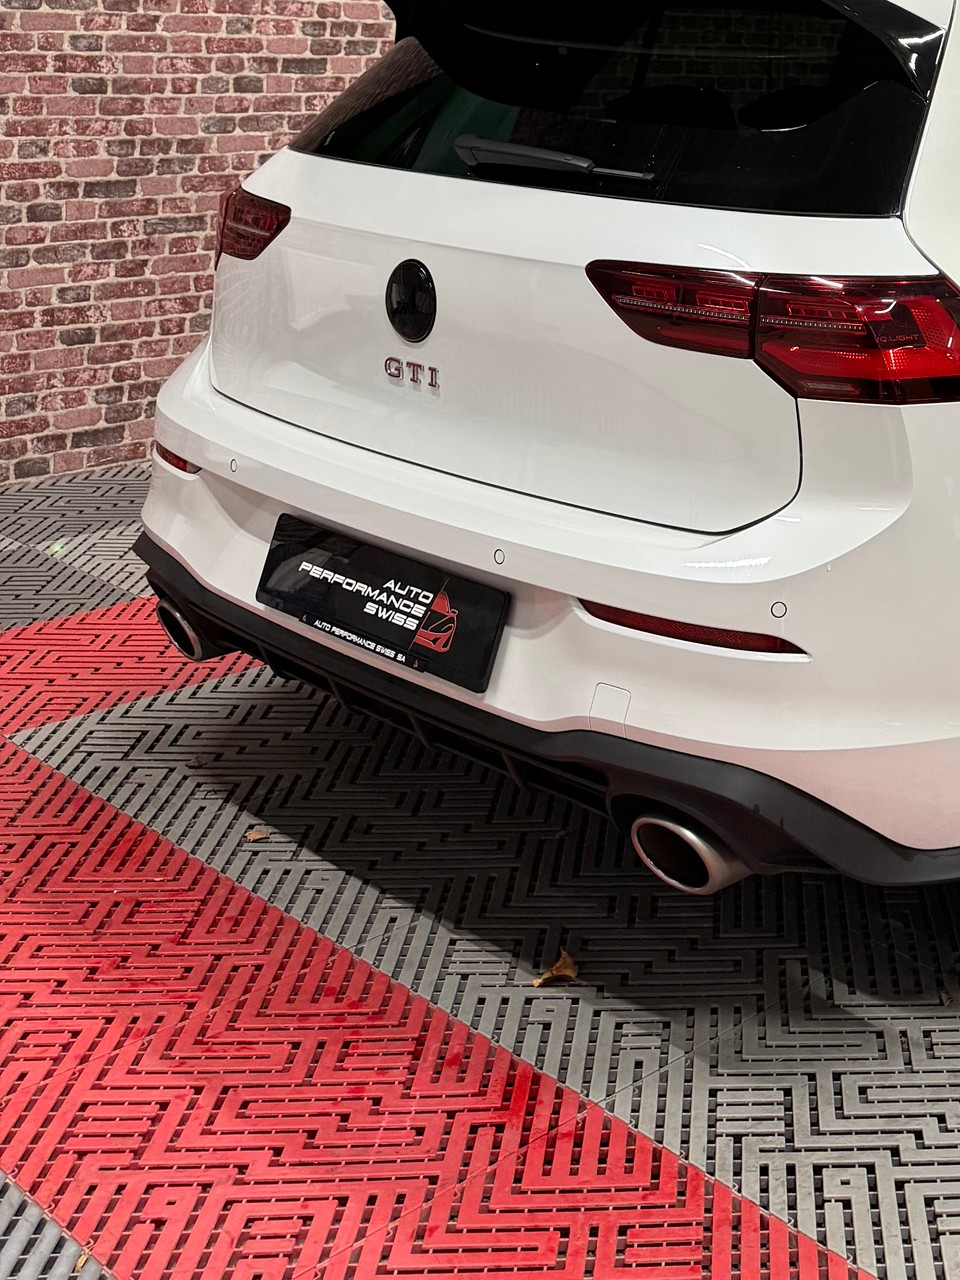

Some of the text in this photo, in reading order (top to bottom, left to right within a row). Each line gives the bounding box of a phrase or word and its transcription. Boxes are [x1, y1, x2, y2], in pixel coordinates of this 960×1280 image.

[384, 356, 440, 388] GTI
[299, 561, 427, 617] PERFORMANCE
[383, 579, 434, 604] AUTO
[363, 601, 419, 631] SWISS
[314, 619, 406, 663] AUTO PERFORMANCE SWISS SA
